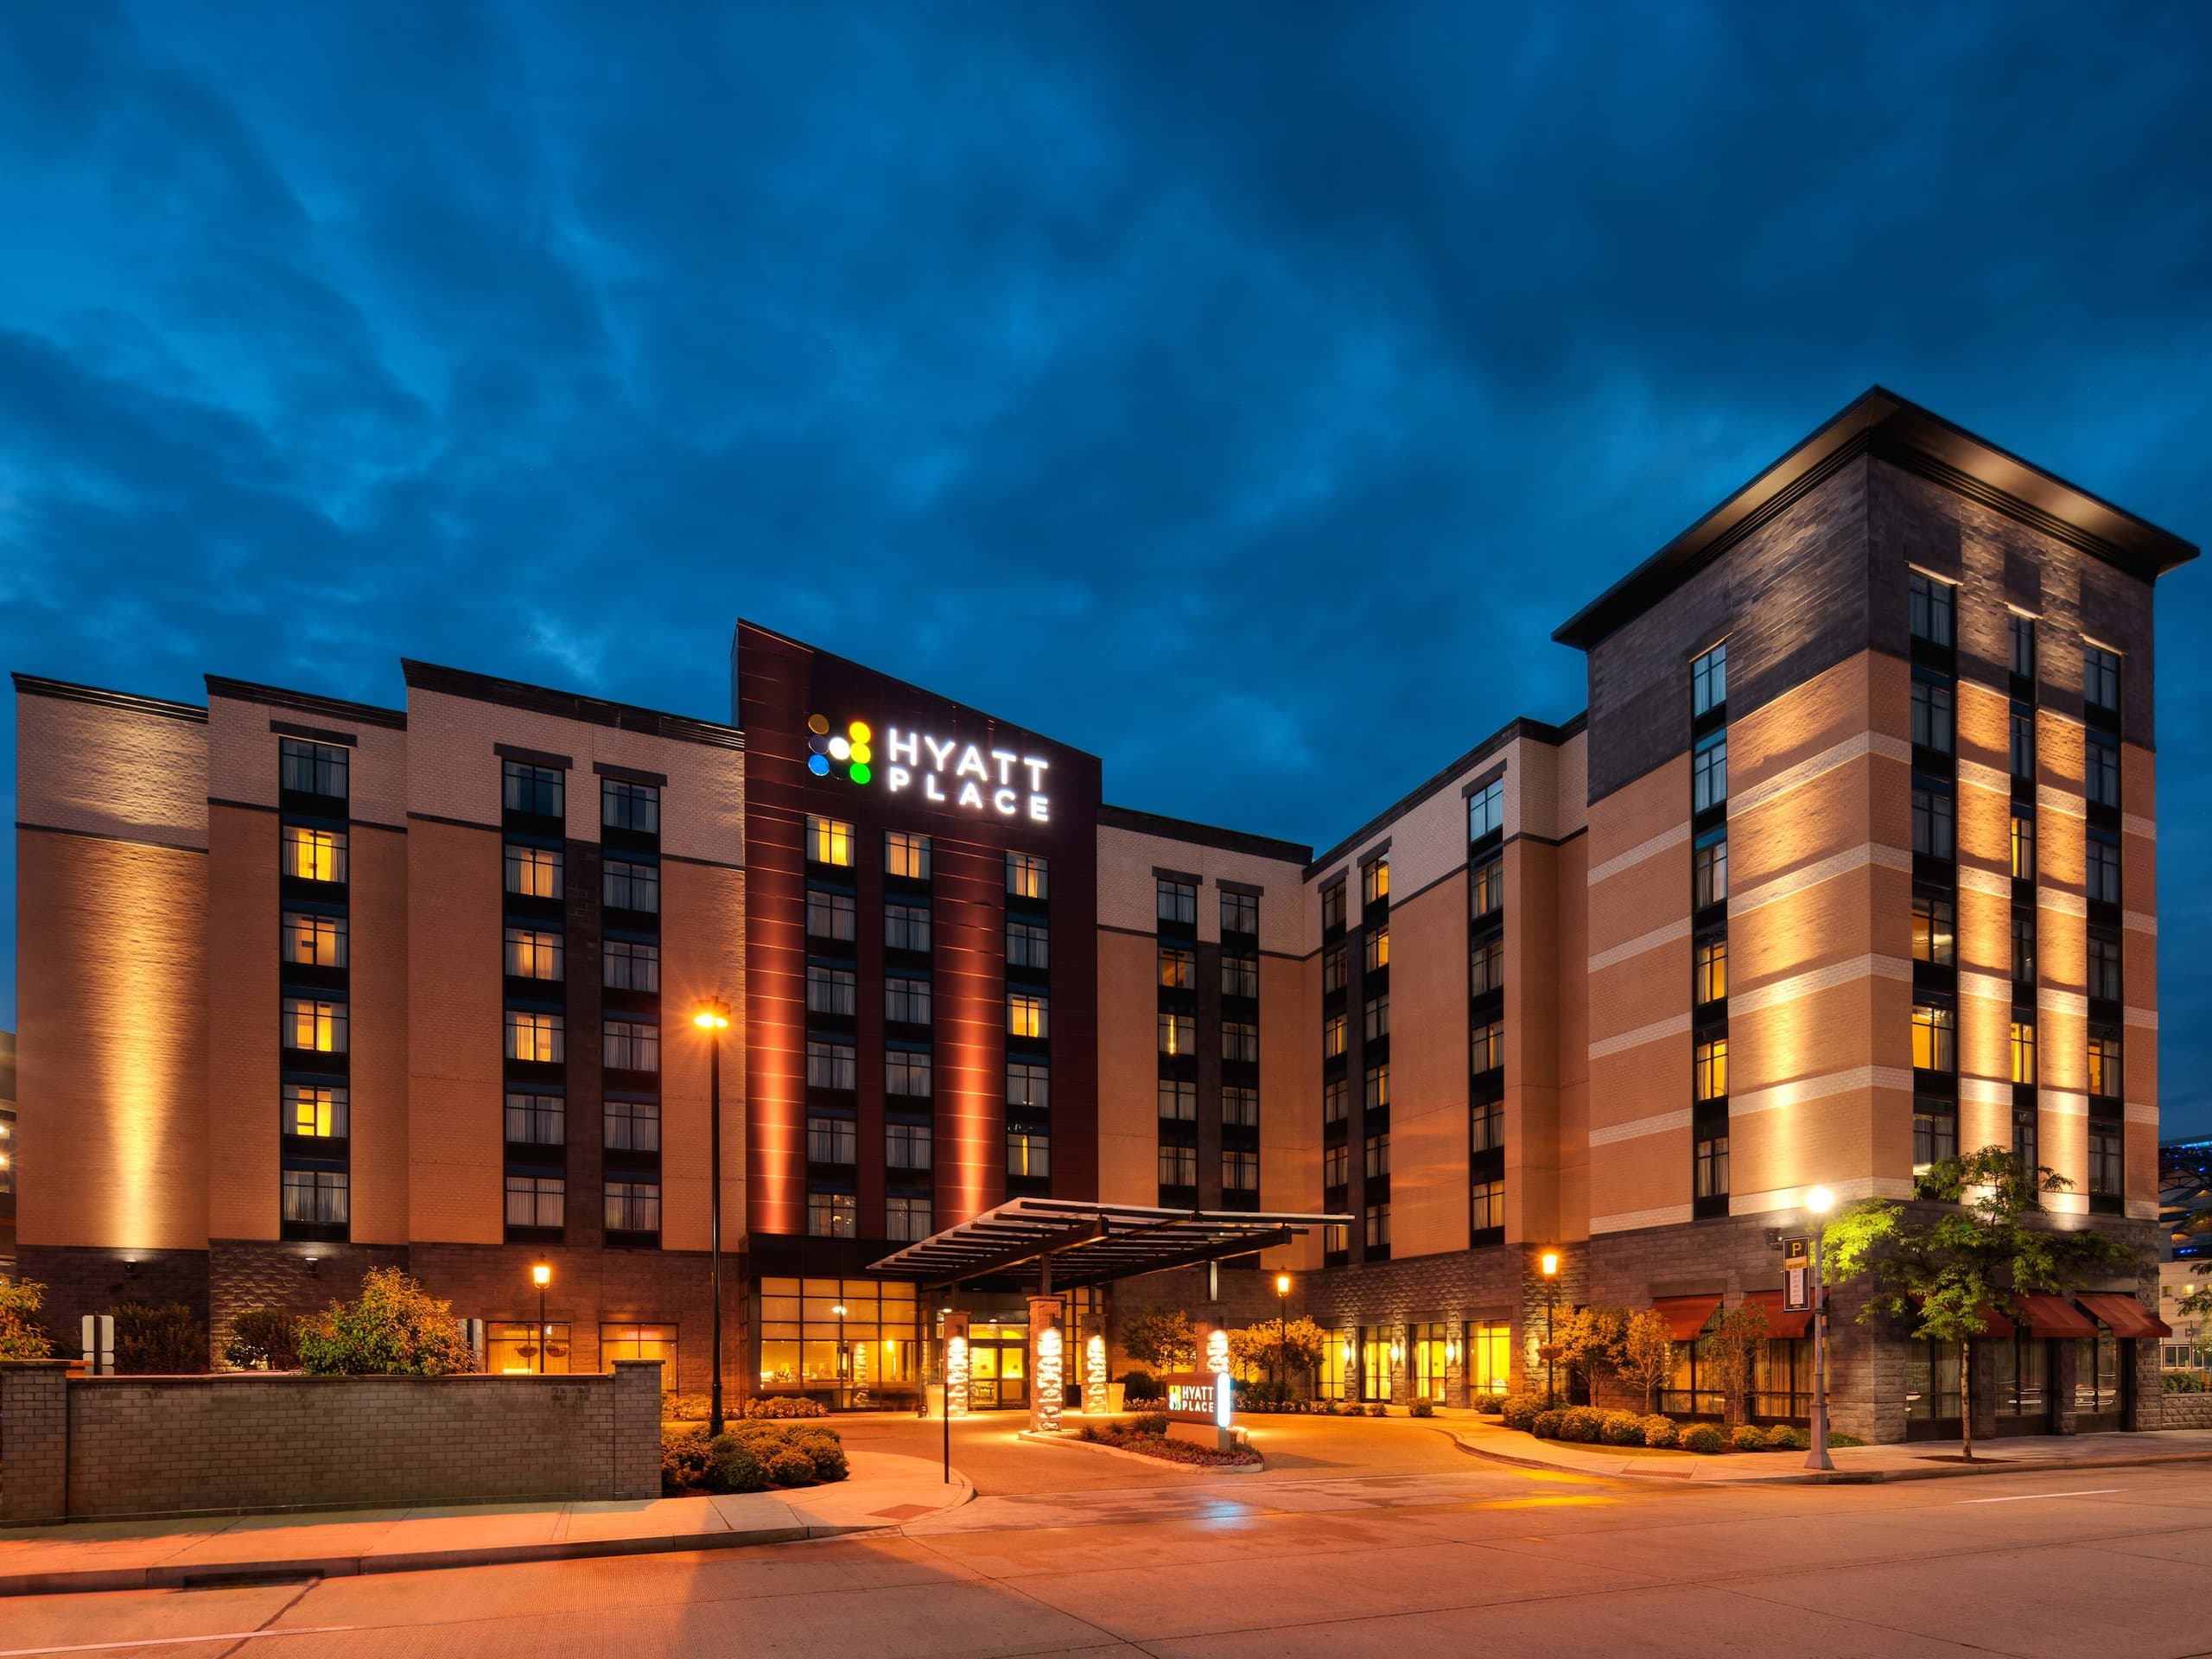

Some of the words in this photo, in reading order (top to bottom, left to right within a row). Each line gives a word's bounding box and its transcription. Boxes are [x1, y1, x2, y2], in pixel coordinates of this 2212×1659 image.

[888, 728, 1049, 791] HYATT
[889, 766, 1049, 822] PLACE
[1791, 1242, 1802, 1256] P
[1182, 1386, 1214, 1401] HYATT
[1182, 1401, 1214, 1413] PLACE
